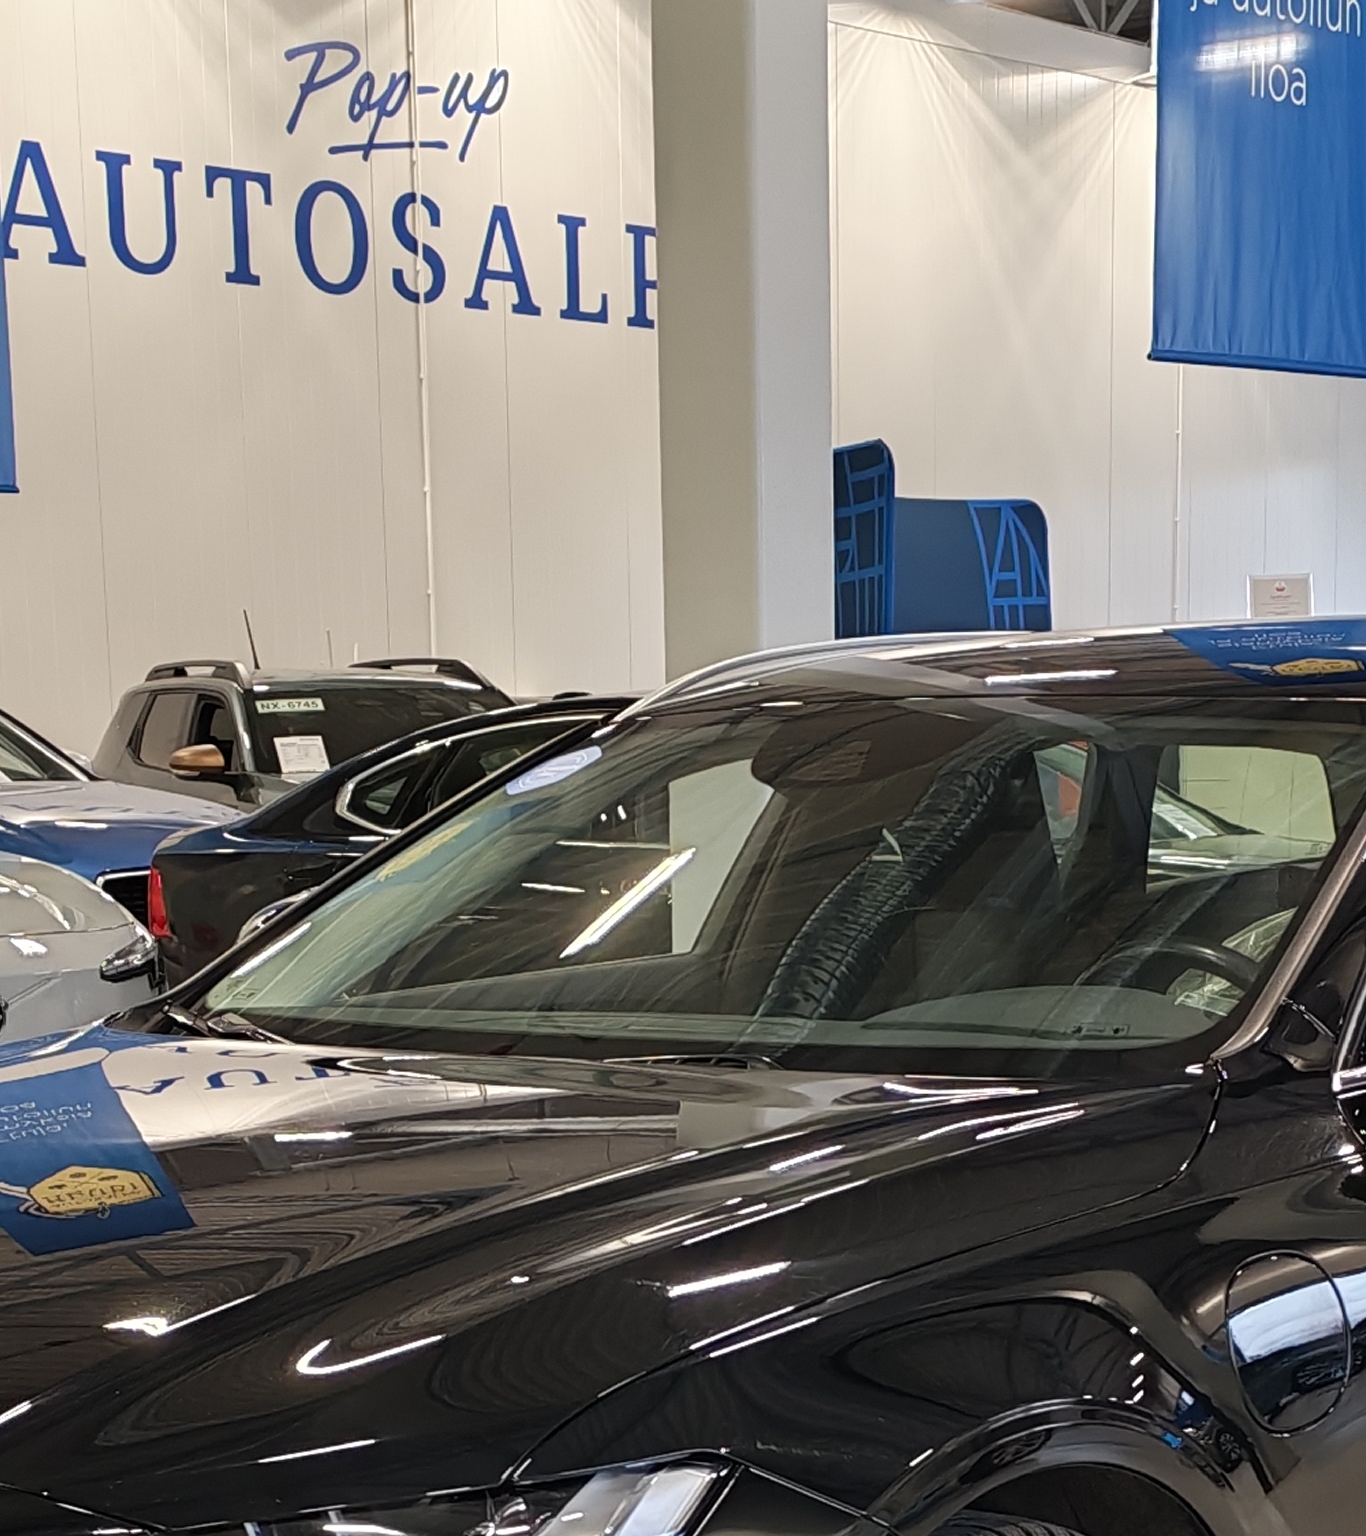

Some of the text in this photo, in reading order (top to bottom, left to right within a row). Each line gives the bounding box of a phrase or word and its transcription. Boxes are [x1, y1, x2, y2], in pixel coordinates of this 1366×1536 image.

[1232, 0, 1362, 37] oilun
[284, 40, 509, 161] Pop-up
[260, 700, 319, 711] NX-6745
